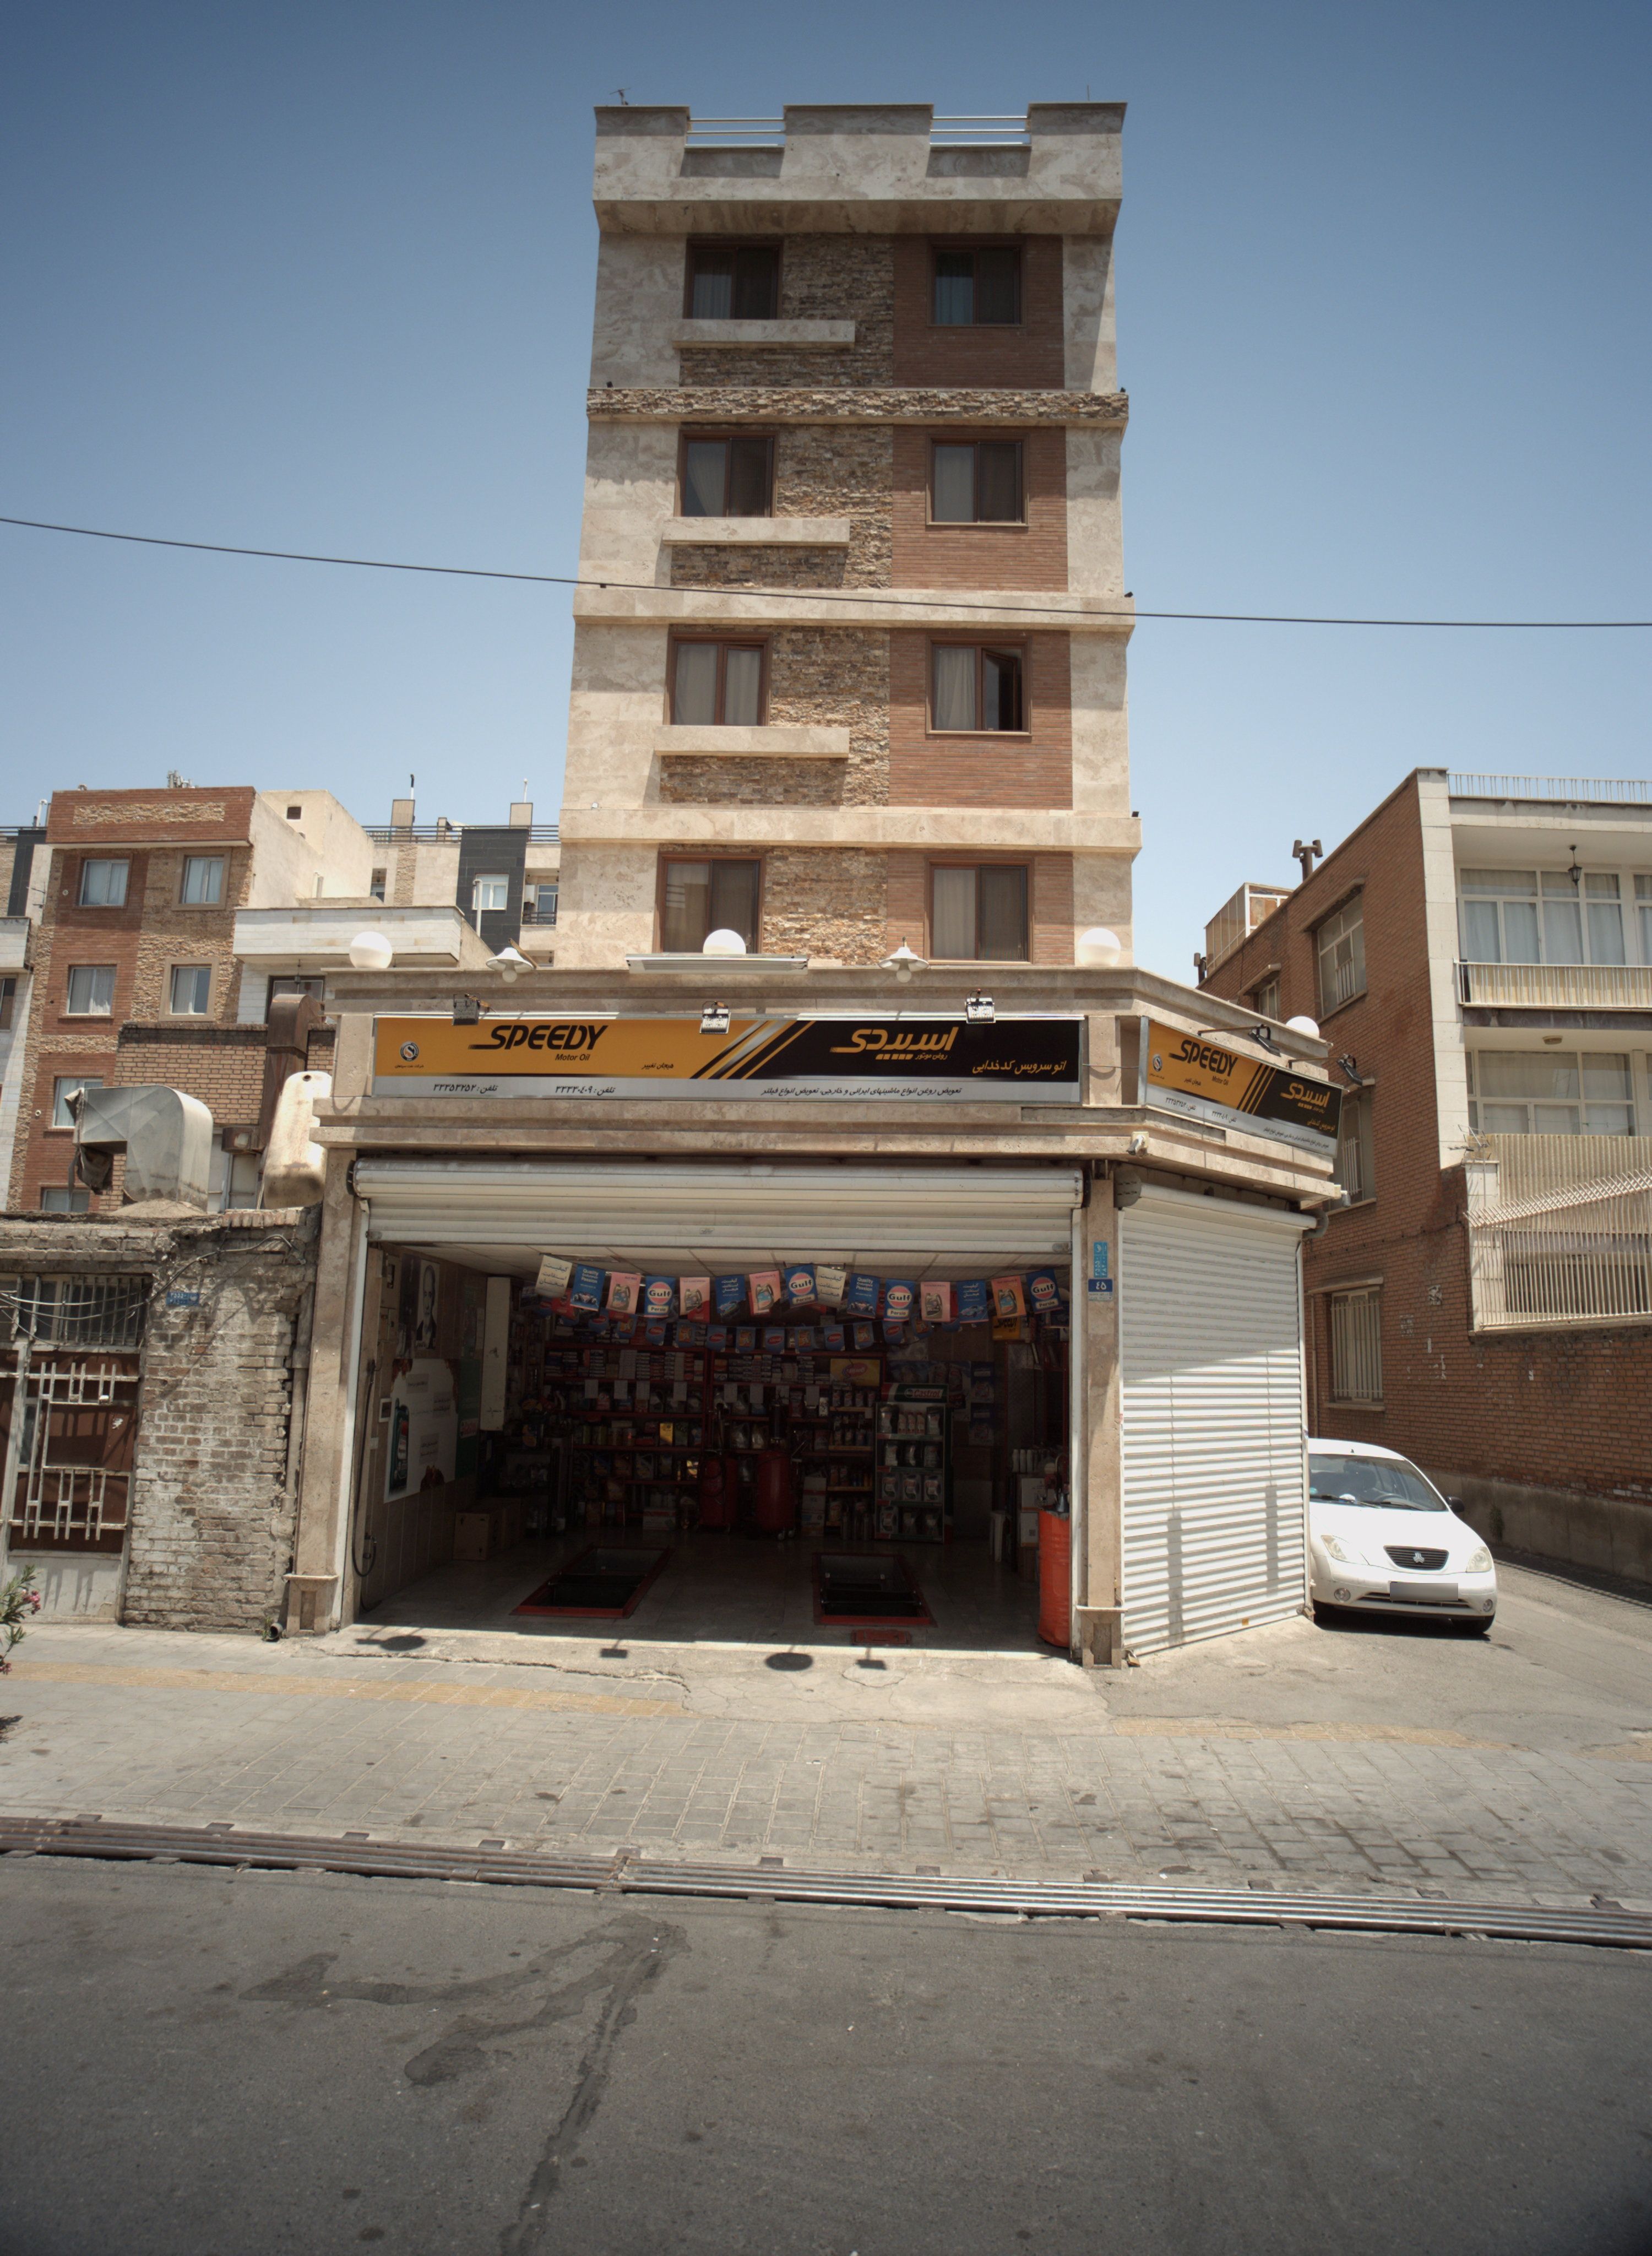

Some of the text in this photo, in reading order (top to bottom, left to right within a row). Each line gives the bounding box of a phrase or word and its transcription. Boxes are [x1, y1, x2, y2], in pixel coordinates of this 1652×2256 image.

[468, 1024, 608, 1050] SPEEDY
[555, 1053, 578, 1061] Motor
[1168, 1039, 1238, 1077] SPEEDY
[1014, 1063, 1052, 1075] سرویس
[1051, 1060, 1067, 1075] اتو
[1211, 1076, 1224, 1085] Motor
[761, 1088, 779, 1096] فیلتر
[779, 1088, 795, 1096] انواع
[795, 1087, 819, 1096] تعویض
[850, 1087, 870, 1096] ایرانی
[900, 1088, 917, 1096] انواع
[937, 1087, 963, 1096] تعویض
[791, 1279, 813, 1289] Gulf
[1032, 1284, 1055, 1294] Gulf
[888, 1293, 911, 1301] Gulf
[914, 1389, 941, 1398] Castrol
